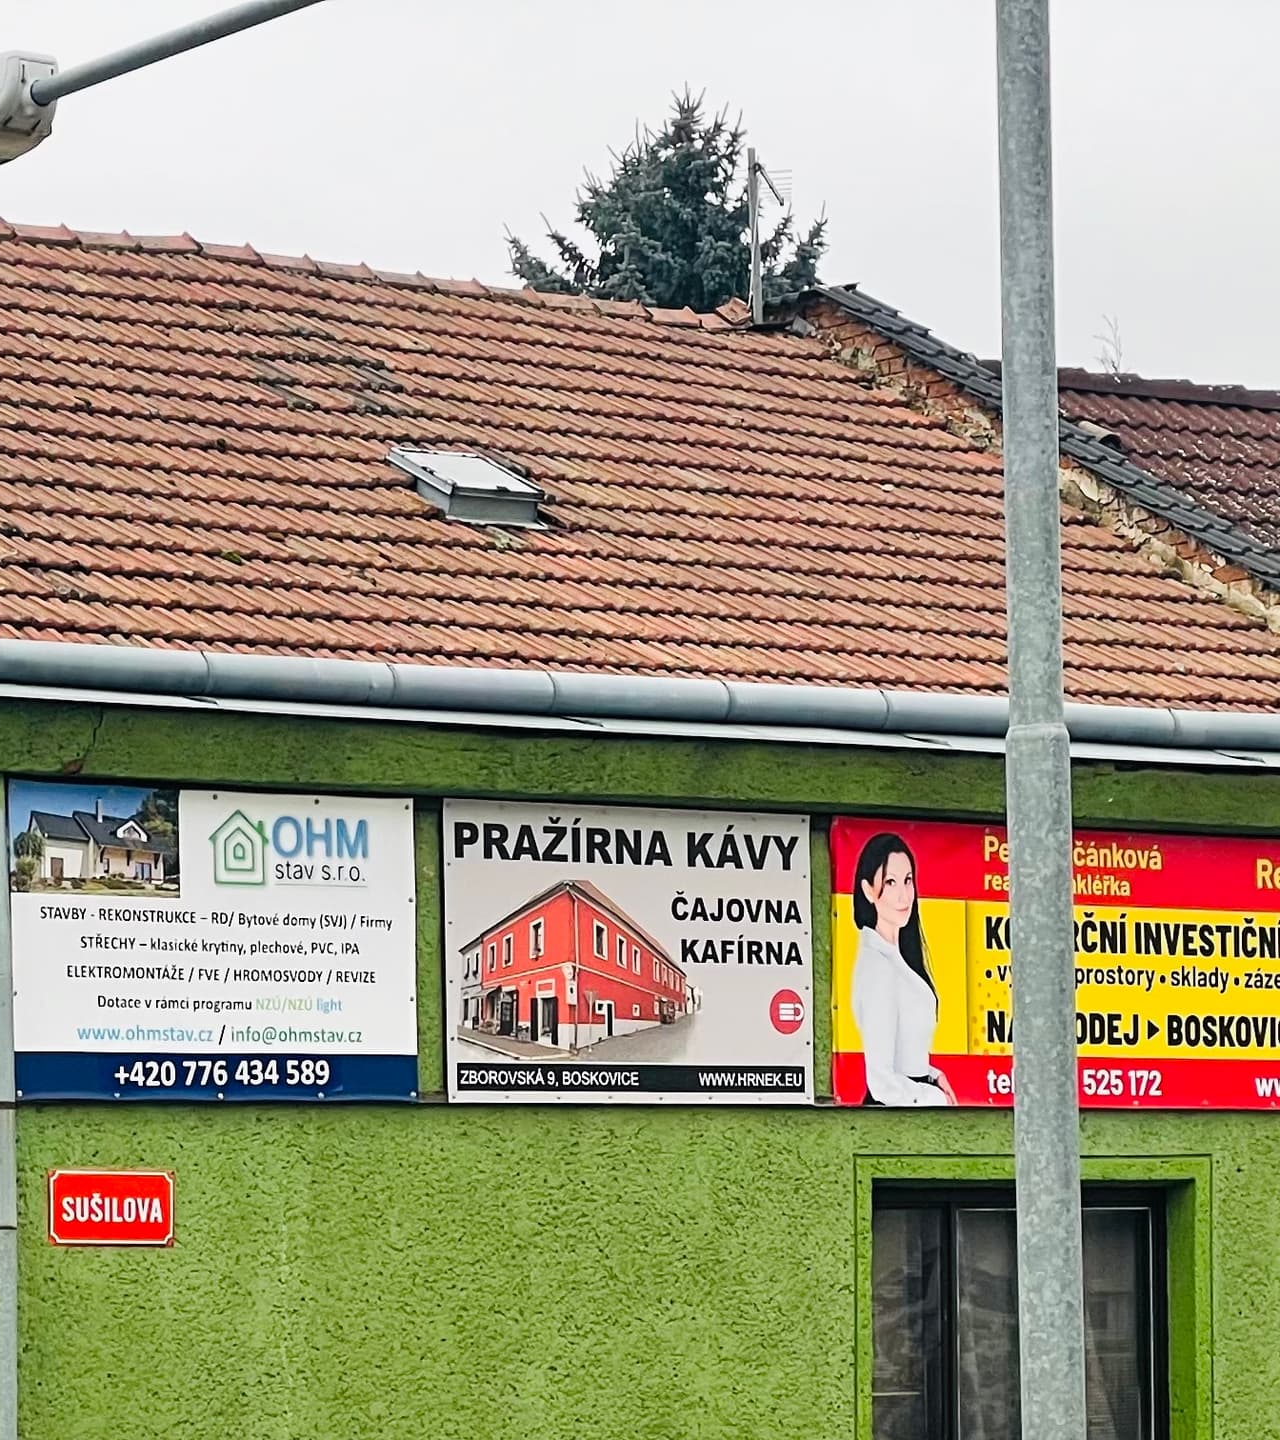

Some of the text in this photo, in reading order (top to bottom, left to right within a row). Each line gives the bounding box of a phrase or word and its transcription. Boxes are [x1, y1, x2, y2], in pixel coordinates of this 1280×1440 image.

[271, 815, 370, 859] OHM
[453, 816, 800, 871] PRAŽÍRNA KÁVY
[275, 861, 366, 882] stav s.r.o.
[40, 906, 87, 920] STAVBY
[98, 908, 197, 924] REKONSTRUKCE
[238, 912, 280, 928] Bytové
[282, 913, 317, 930] domy
[319, 913, 347, 930] (SVJ)
[360, 915, 393, 931] Firmy
[671, 891, 803, 924] ČAJOVNA
[80, 933, 136, 950] STŘECHY
[150, 937, 198, 952] klasické
[201, 938, 247, 956] krytiny,
[250, 940, 308, 956] plechové,
[311, 942, 338, 956] PVC,
[341, 942, 360, 955] IPA
[681, 935, 803, 965] KAFÍRNA
[66, 964, 185, 981] ELEKTROMONTÁŽE
[198, 968, 220, 981] FVE
[233, 969, 323, 983] HROMOSVODY
[335, 970, 376, 984] REVIZE
[1075, 964, 1156, 992] prostory
[1170, 965, 1229, 994] sklady
[97, 995, 142, 1009] Dotace
[145, 999, 152, 1009] v
[155, 996, 190, 1009] rámci
[193, 998, 252, 1013] programu
[316, 997, 343, 1014] light
[77, 1025, 214, 1042] www.ohmstav.cz
[231, 1026, 363, 1045] info@ohmstav.cz
[114, 1059, 331, 1087] +420 776 434 589
[460, 1068, 639, 1088] ZBOROVSKÁ 9, BOSKOVICE
[698, 1071, 803, 1087] WWW.HRNEK.EU
[1082, 1069, 1124, 1096] 525
[1127, 1069, 1163, 1097] 172
[61, 1192, 163, 1224] SUŠILOVA
